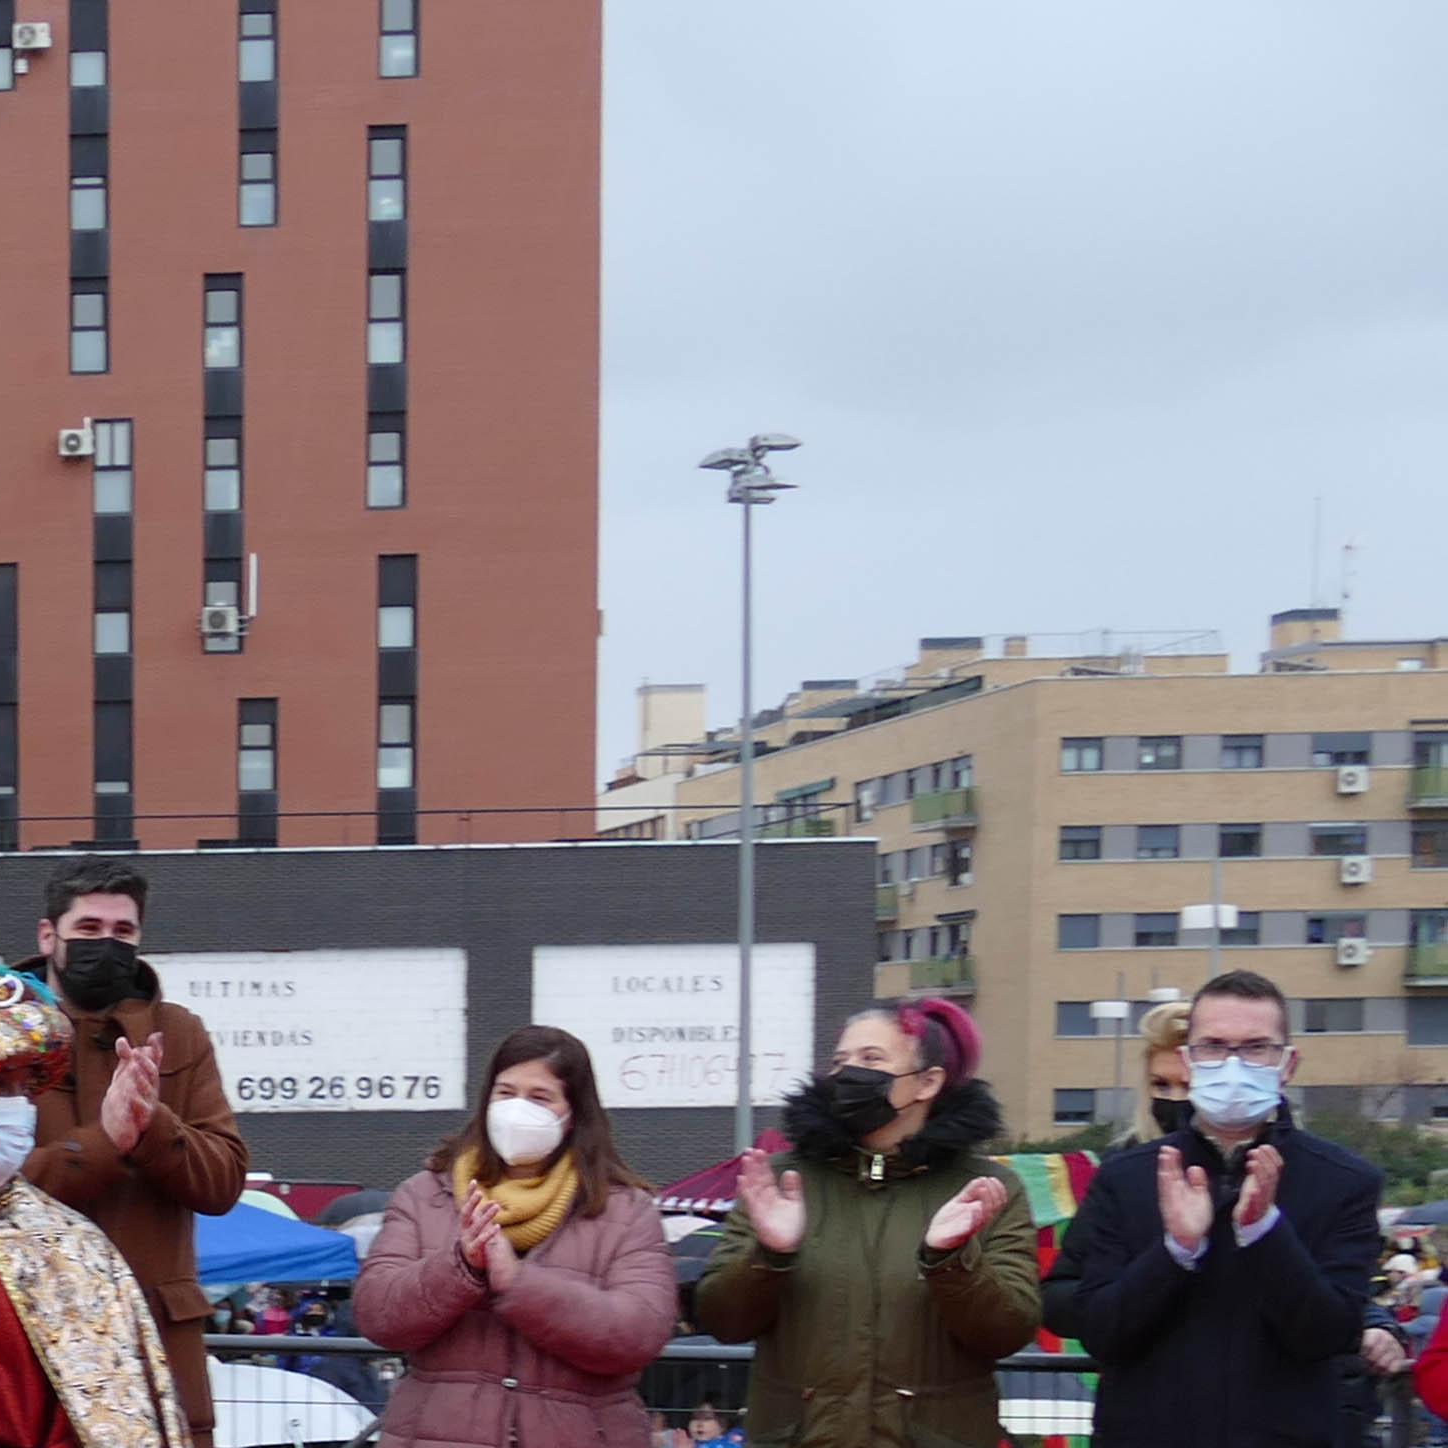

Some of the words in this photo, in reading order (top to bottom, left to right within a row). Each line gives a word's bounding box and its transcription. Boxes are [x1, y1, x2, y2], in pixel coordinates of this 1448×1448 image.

[189, 980, 296, 998] ULTIMAS
[612, 975, 724, 994] LOCALES
[208, 1030, 314, 1048] VIENDAS
[611, 1024, 739, 1044] DISPONIBLE
[236, 1075, 298, 1101] 699
[307, 1075, 346, 1100] 26
[355, 1075, 396, 1099] 96
[402, 1075, 441, 1099] 76
